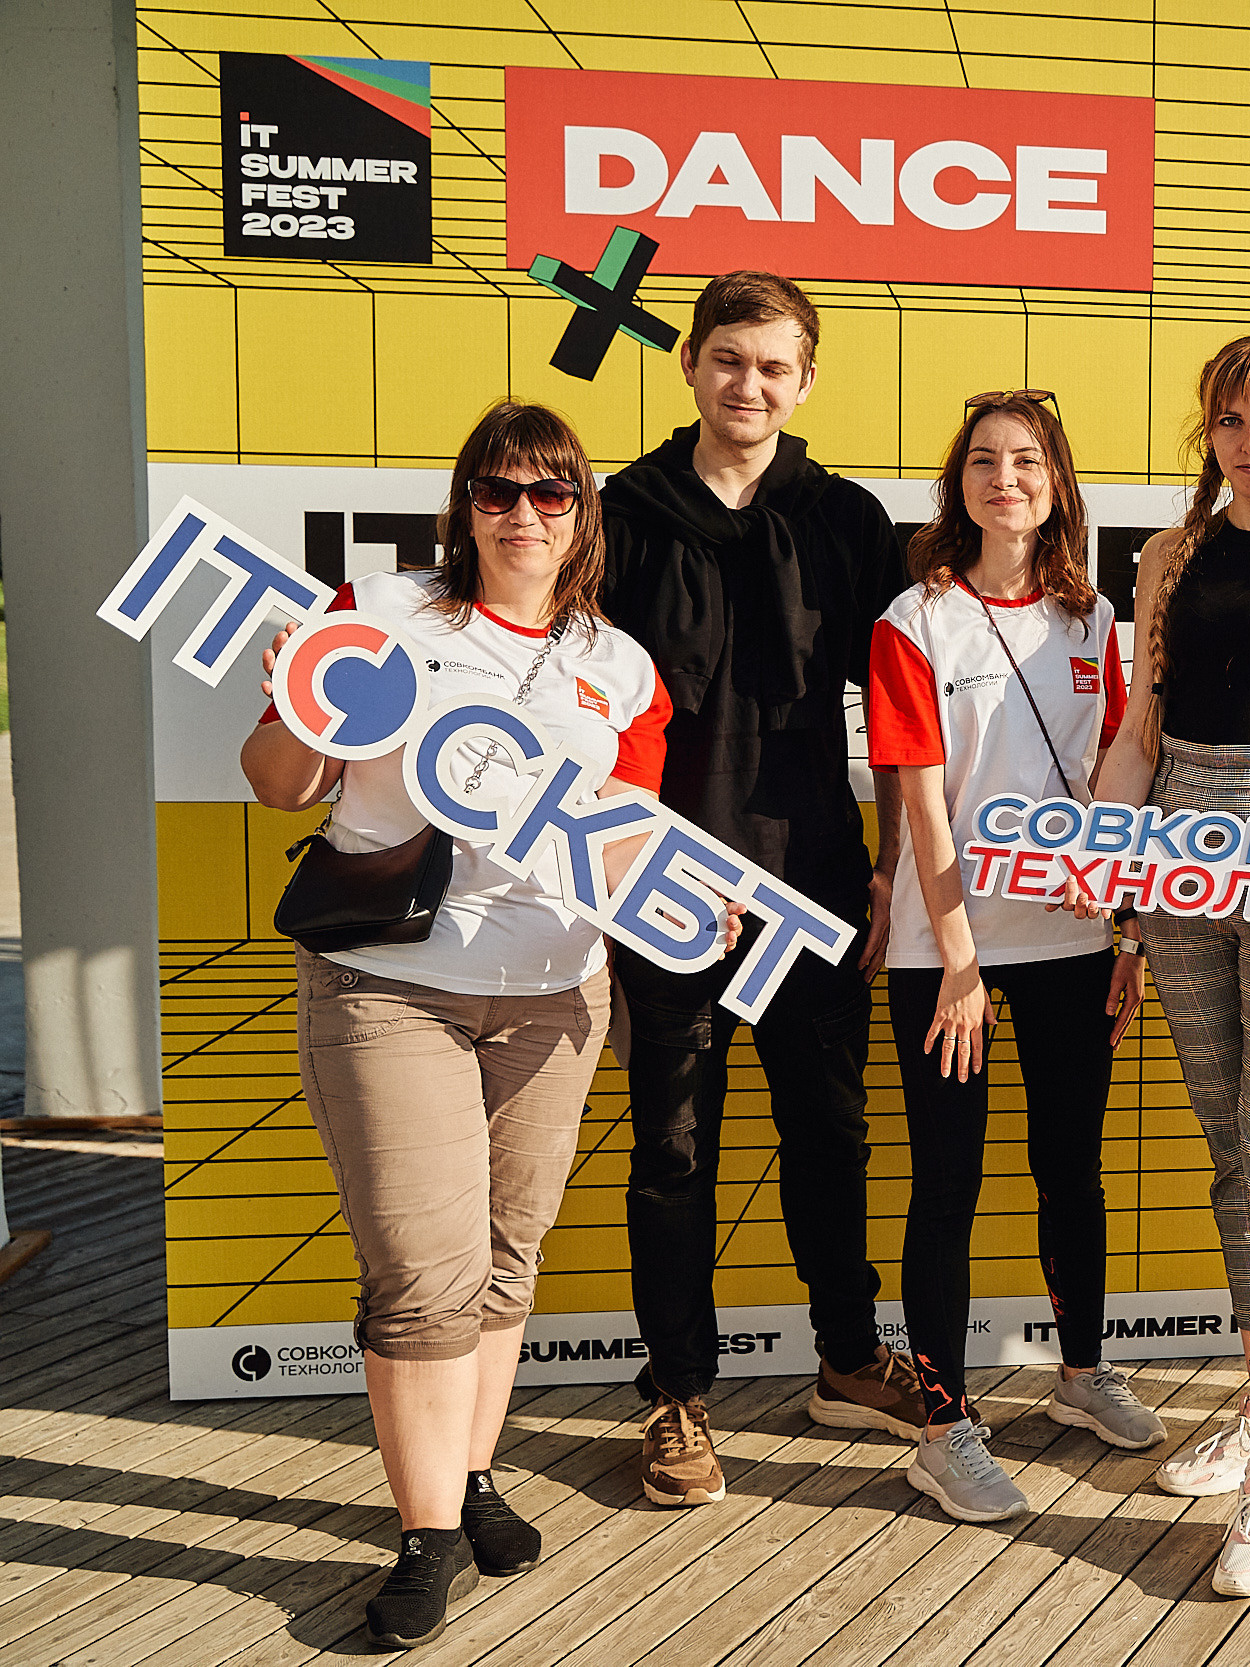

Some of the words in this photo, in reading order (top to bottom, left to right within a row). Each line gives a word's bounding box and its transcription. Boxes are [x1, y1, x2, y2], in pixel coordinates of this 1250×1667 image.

[240, 153, 418, 184] SUMMER
[564, 125, 1108, 235] DANCE
[241, 182, 347, 210] FEST
[241, 212, 356, 240] 2023
[1024, 1321, 1058, 1343] IT
[277, 1345, 365, 1362] СОВКОМ
[518, 1337, 649, 1364] SUMME
[278, 1362, 363, 1377] ТЕХНОЛОГ
